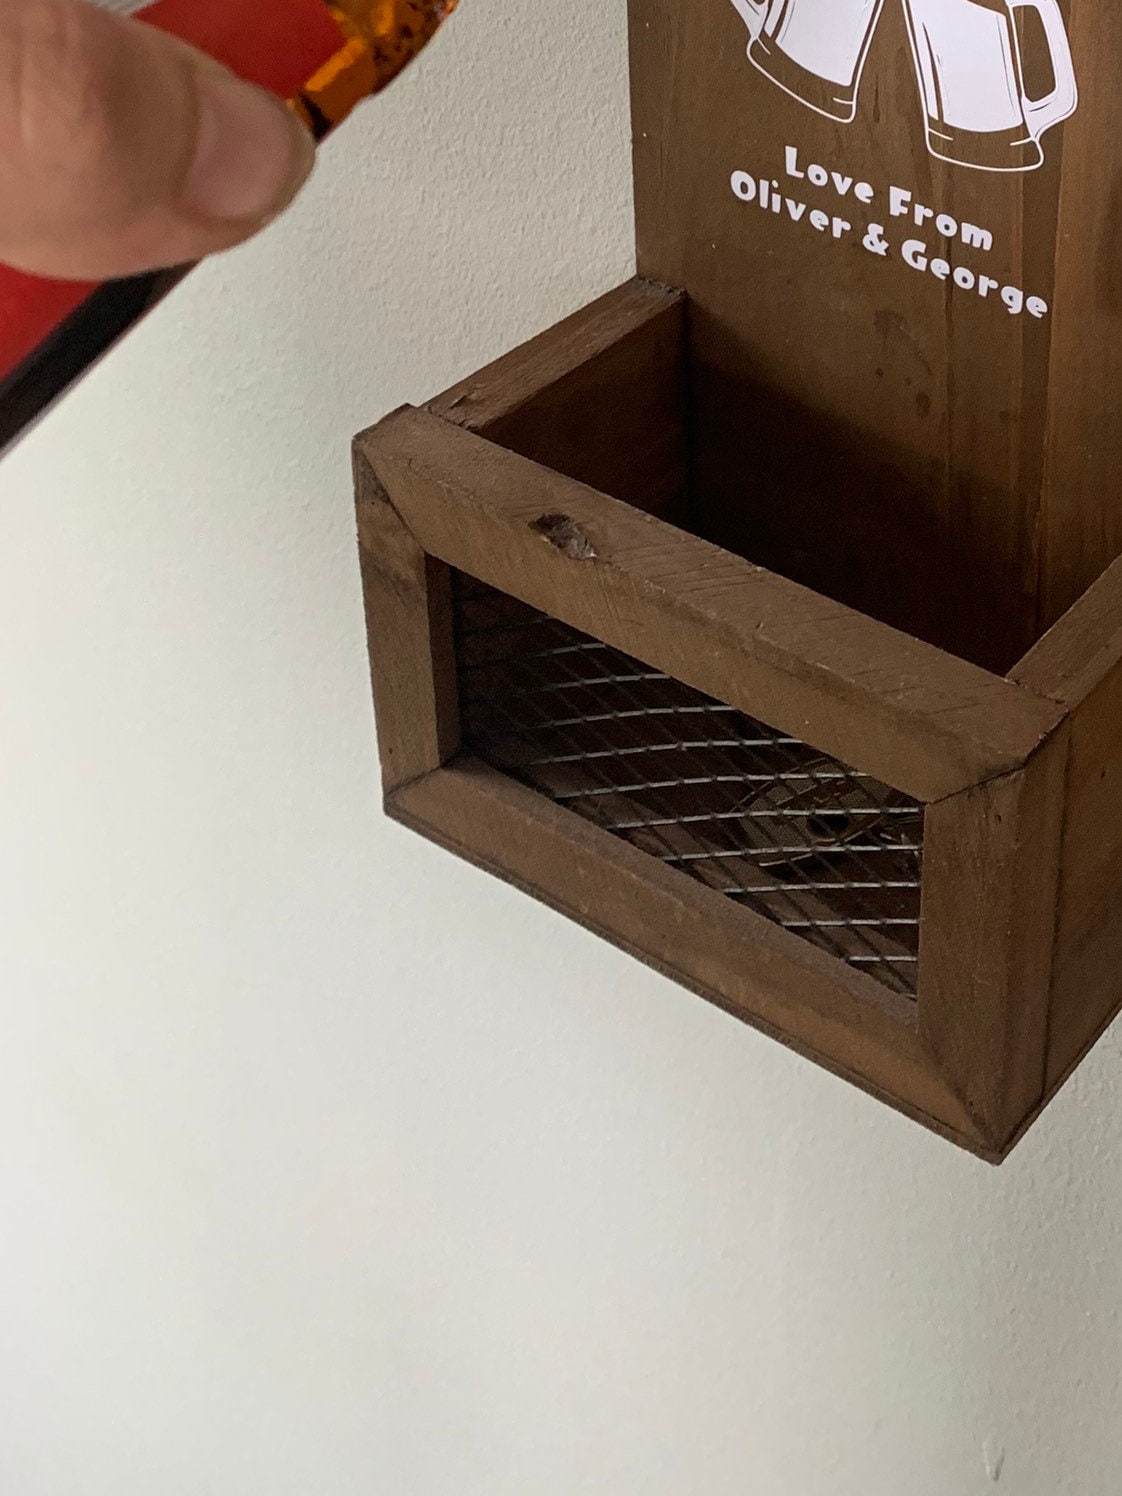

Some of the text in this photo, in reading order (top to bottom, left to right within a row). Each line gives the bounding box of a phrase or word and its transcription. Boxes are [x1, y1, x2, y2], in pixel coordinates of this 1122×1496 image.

[730, 170, 1049, 319] Oliver & George
[784, 145, 993, 251] Love From
